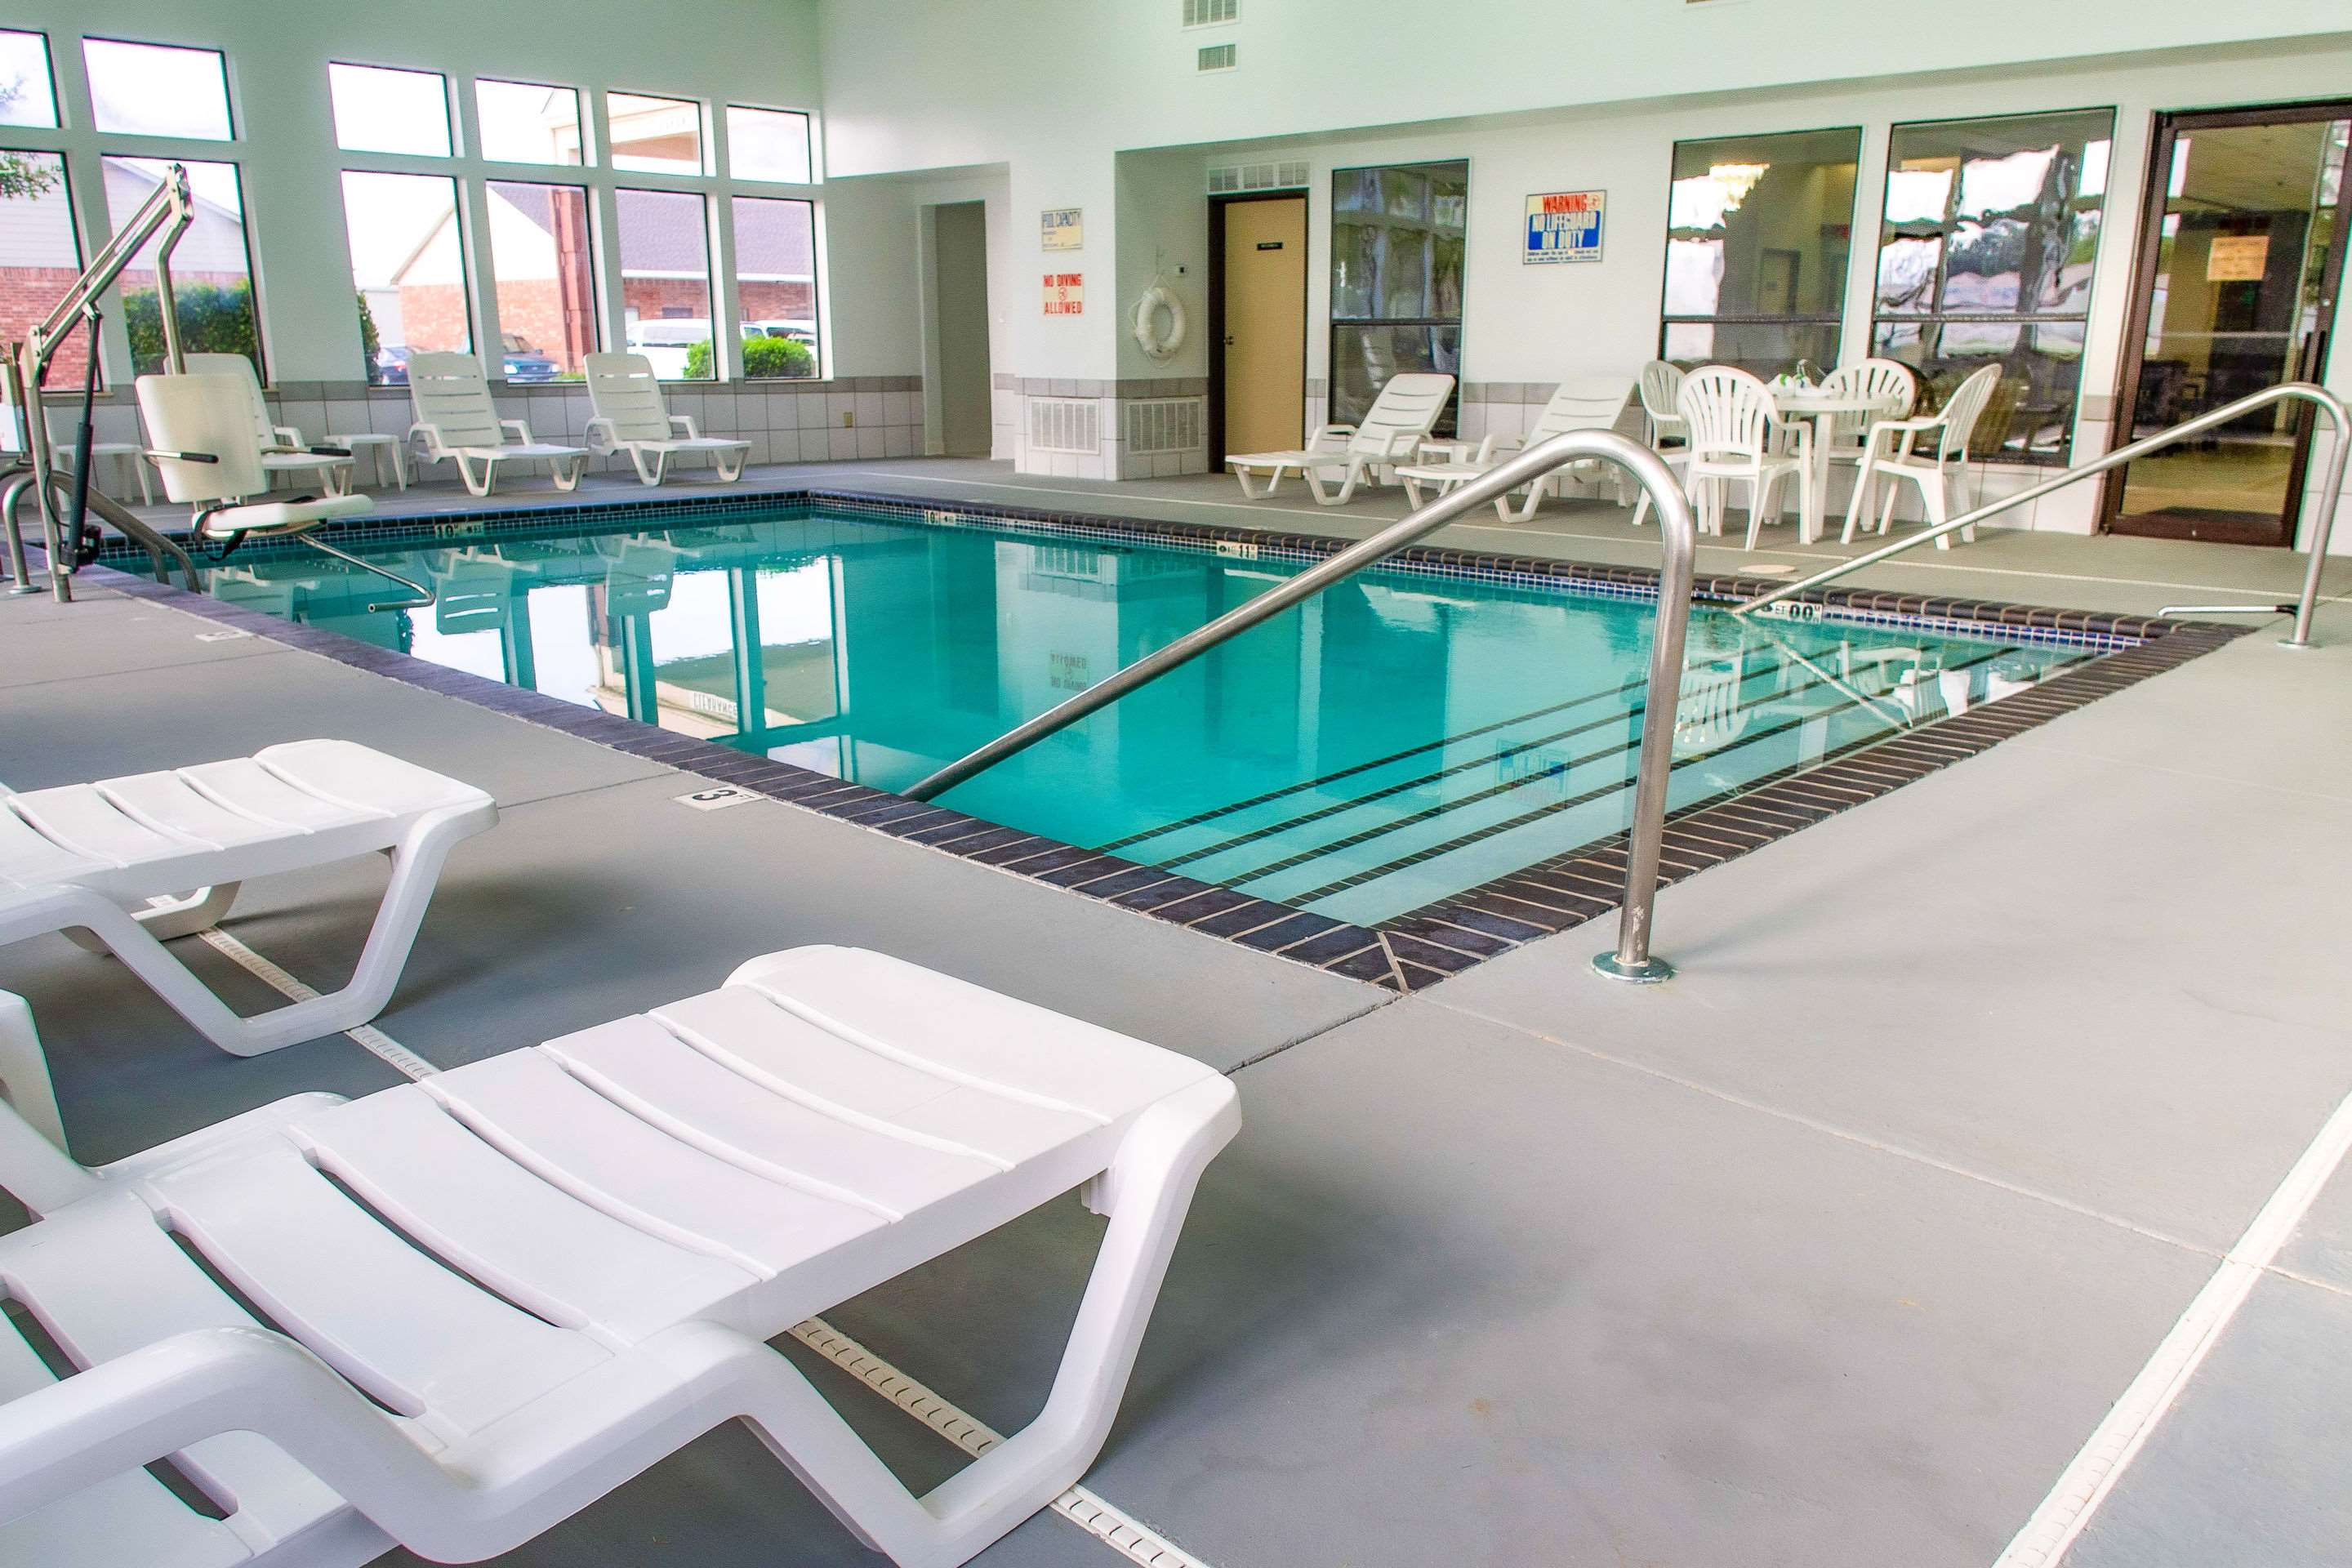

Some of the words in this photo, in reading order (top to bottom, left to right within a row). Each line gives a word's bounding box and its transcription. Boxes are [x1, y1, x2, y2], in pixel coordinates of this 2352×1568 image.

[1542, 195, 1587, 213] WARNING
[1042, 213, 1054, 228] POOL
[1056, 212, 1081, 227] CAPACITY
[1532, 214, 1545, 232] NO
[1547, 210, 1596, 231] LIFEGUARD
[1542, 231, 1556, 249] ON
[1558, 229, 1584, 248] DUTY
[1044, 274, 1054, 287] NO
[1057, 274, 1081, 287] DIVING
[1045, 301, 1083, 314] ALLOWED
[693, 790, 737, 800] 3
